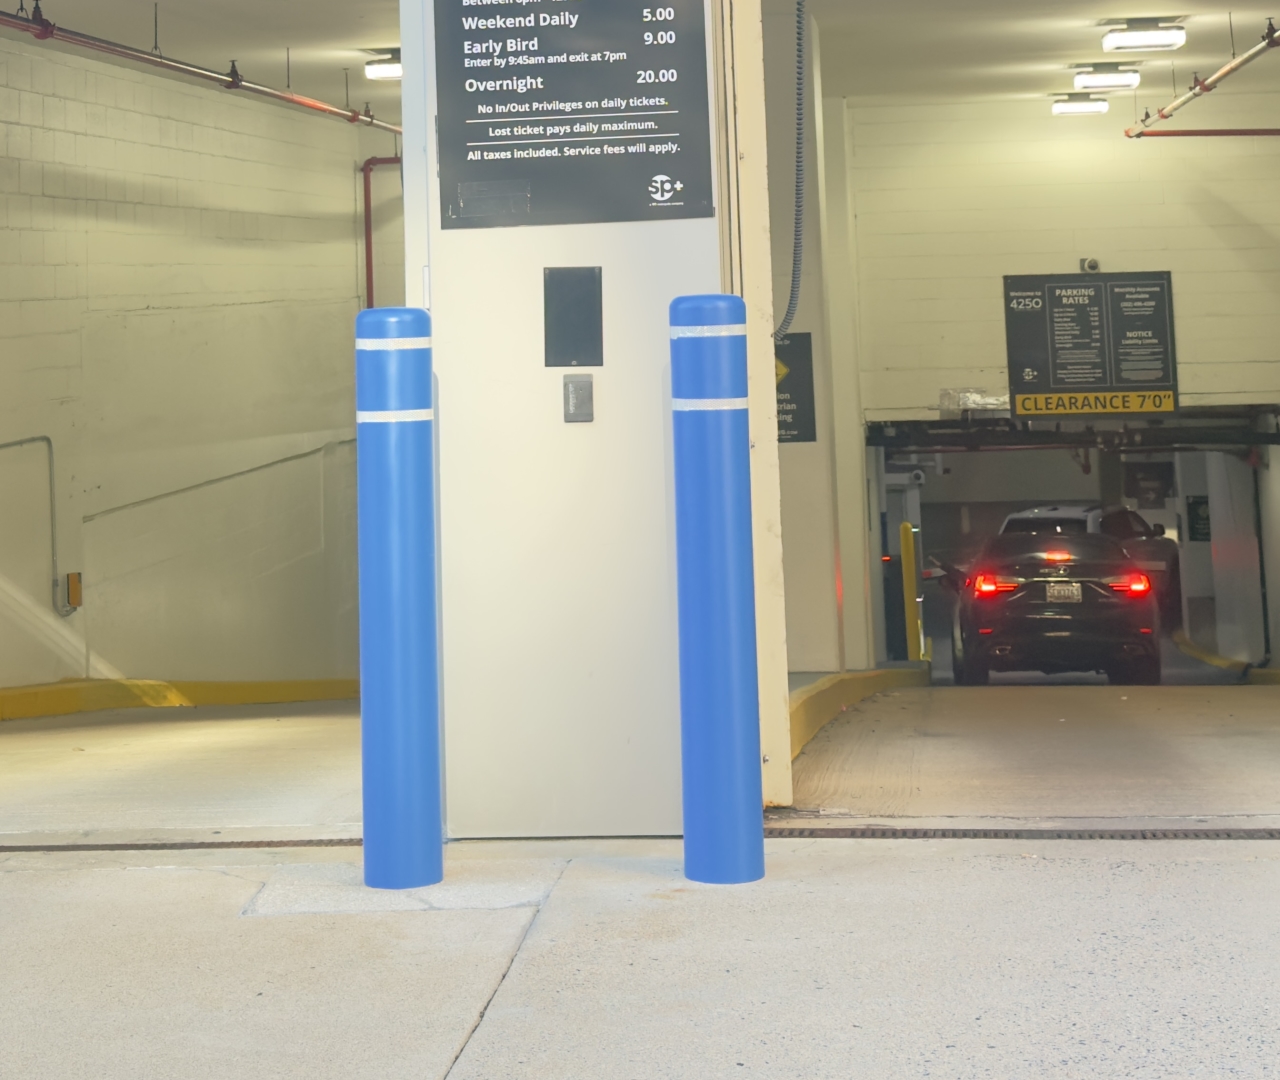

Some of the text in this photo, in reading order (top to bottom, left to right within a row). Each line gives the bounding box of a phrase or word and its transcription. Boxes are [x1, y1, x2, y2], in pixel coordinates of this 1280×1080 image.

[462, 8, 674, 29] Weekend Daily 5.00
[464, 31, 675, 56] Early Bird 9.00
[465, 52, 626, 68] Enter by 9:45am and exit at 7pm
[465, 69, 677, 93] Overnight 20.00
[478, 105, 493, 113] No
[496, 103, 529, 112] In/Out
[533, 101, 582, 111] Privileges
[601, 98, 627, 109] daily
[629, 97, 668, 106] tickets.
[489, 121, 658, 136] Lost ticket pays daily maximum.
[468, 151, 481, 160] All
[514, 147, 561, 158] included.
[564, 146, 601, 155] Service
[603, 145, 625, 154] fees
[628, 143, 646, 152] will
[649, 142, 680, 154] apply.
[1056, 288, 1094, 296] PARKING
[1010, 298, 1042, 309] 4250
[1022, 395, 1131, 411] CLEARANCE
